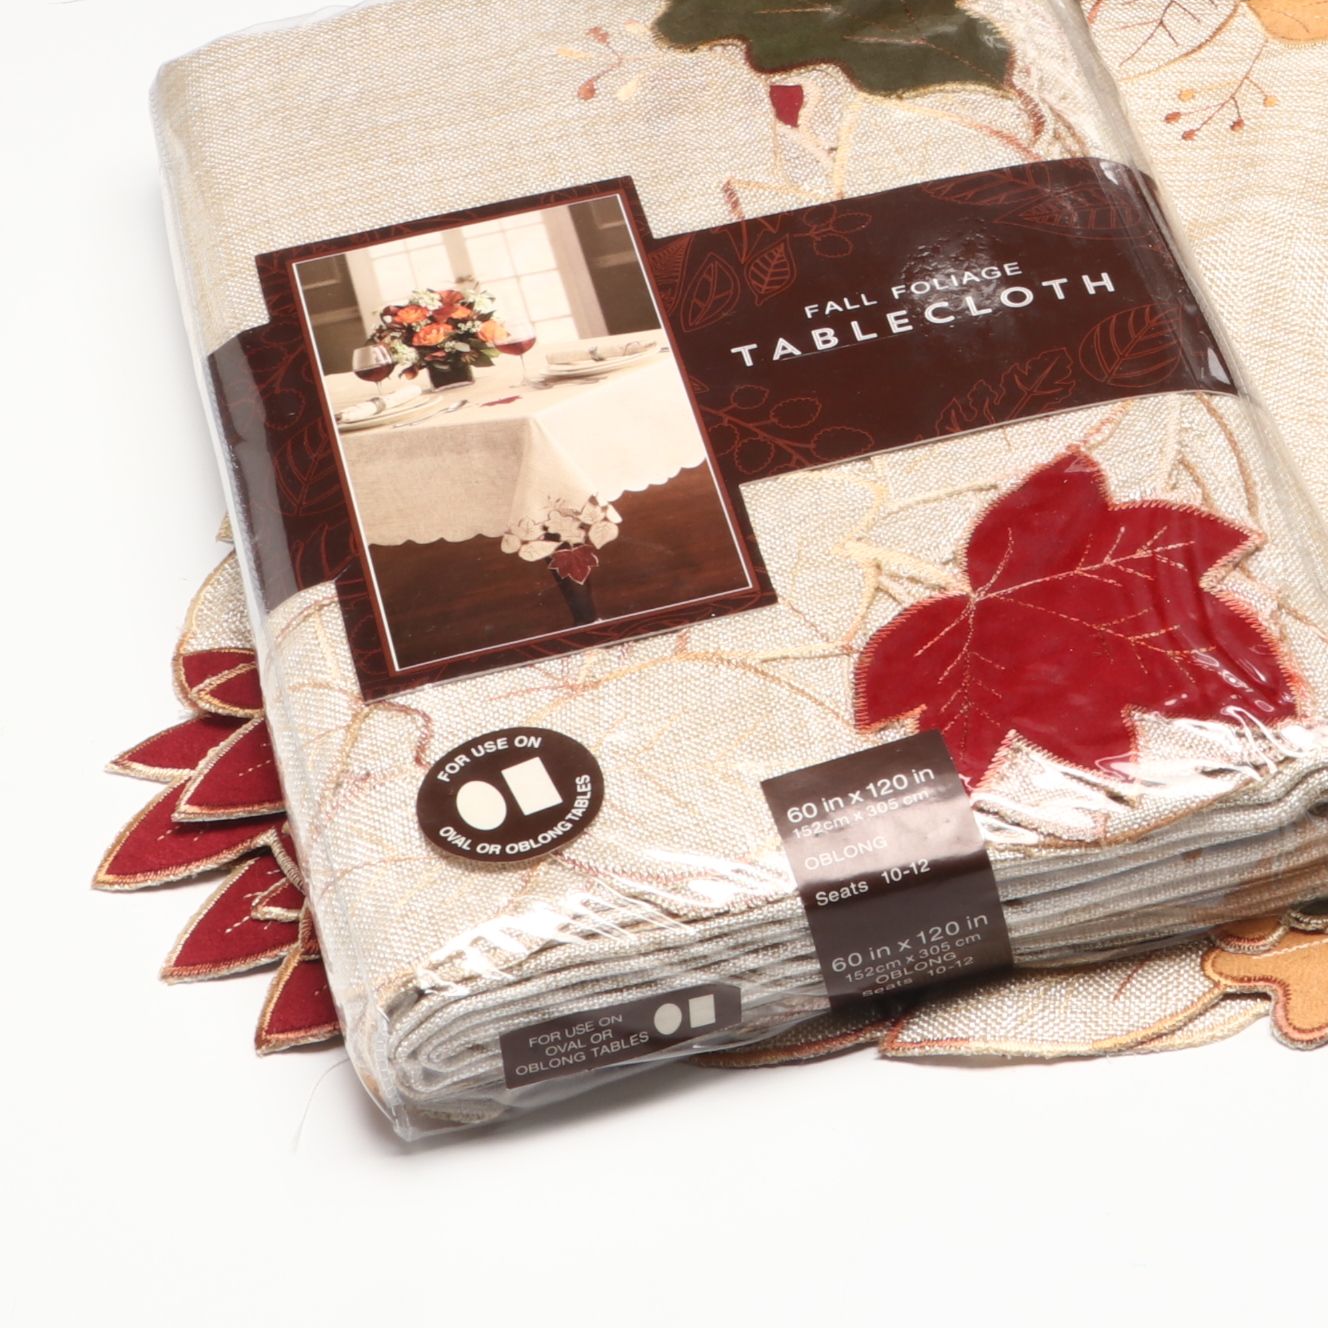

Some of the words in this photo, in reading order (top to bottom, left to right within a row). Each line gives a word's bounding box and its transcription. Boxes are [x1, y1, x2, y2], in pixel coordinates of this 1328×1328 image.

[804, 293, 878, 319] FALL
[890, 261, 1024, 301] FOLIAGE
[730, 272, 1117, 369] TABLECLOTH
[437, 754, 471, 782] FOR
[470, 737, 508, 757] USE
[514, 735, 542, 749] ON
[439, 826, 471, 851] OVAL
[476, 842, 502, 855] OR
[505, 820, 573, 855] OBLONG
[567, 774, 592, 822] TABLES
[786, 802, 818, 823] 60
[823, 794, 844, 812] in
[850, 790, 864, 804] x
[865, 773, 908, 800] 120
[913, 767, 935, 784] in
[792, 814, 850, 840] 152cm
[852, 811, 863, 822] x
[867, 799, 899, 818] 305
[902, 789, 929, 805] cm
[804, 837, 888, 872] OBLONG
[815, 880, 869, 906] Seats
[880, 858, 931, 885] 10-12
[831, 952, 863, 973] 60
[868, 943, 891, 960] in
[897, 938, 912, 952] x
[916, 921, 961, 945] 120
[966, 913, 989, 930] in
[845, 958, 903, 983] 152cm
[906, 955, 915, 964] x
[918, 942, 951, 959] 305
[955, 933, 982, 948] cm
[875, 952, 957, 985] OBLONG
[515, 1052, 586, 1076] OBLONG
[589, 1031, 649, 1059] TABLES
[528, 1031, 561, 1048] FOR
[564, 1023, 595, 1039] USE
[598, 1014, 623, 1029] ON
[545, 1038, 586, 1057] OVAL
[590, 1029, 613, 1045] OR
